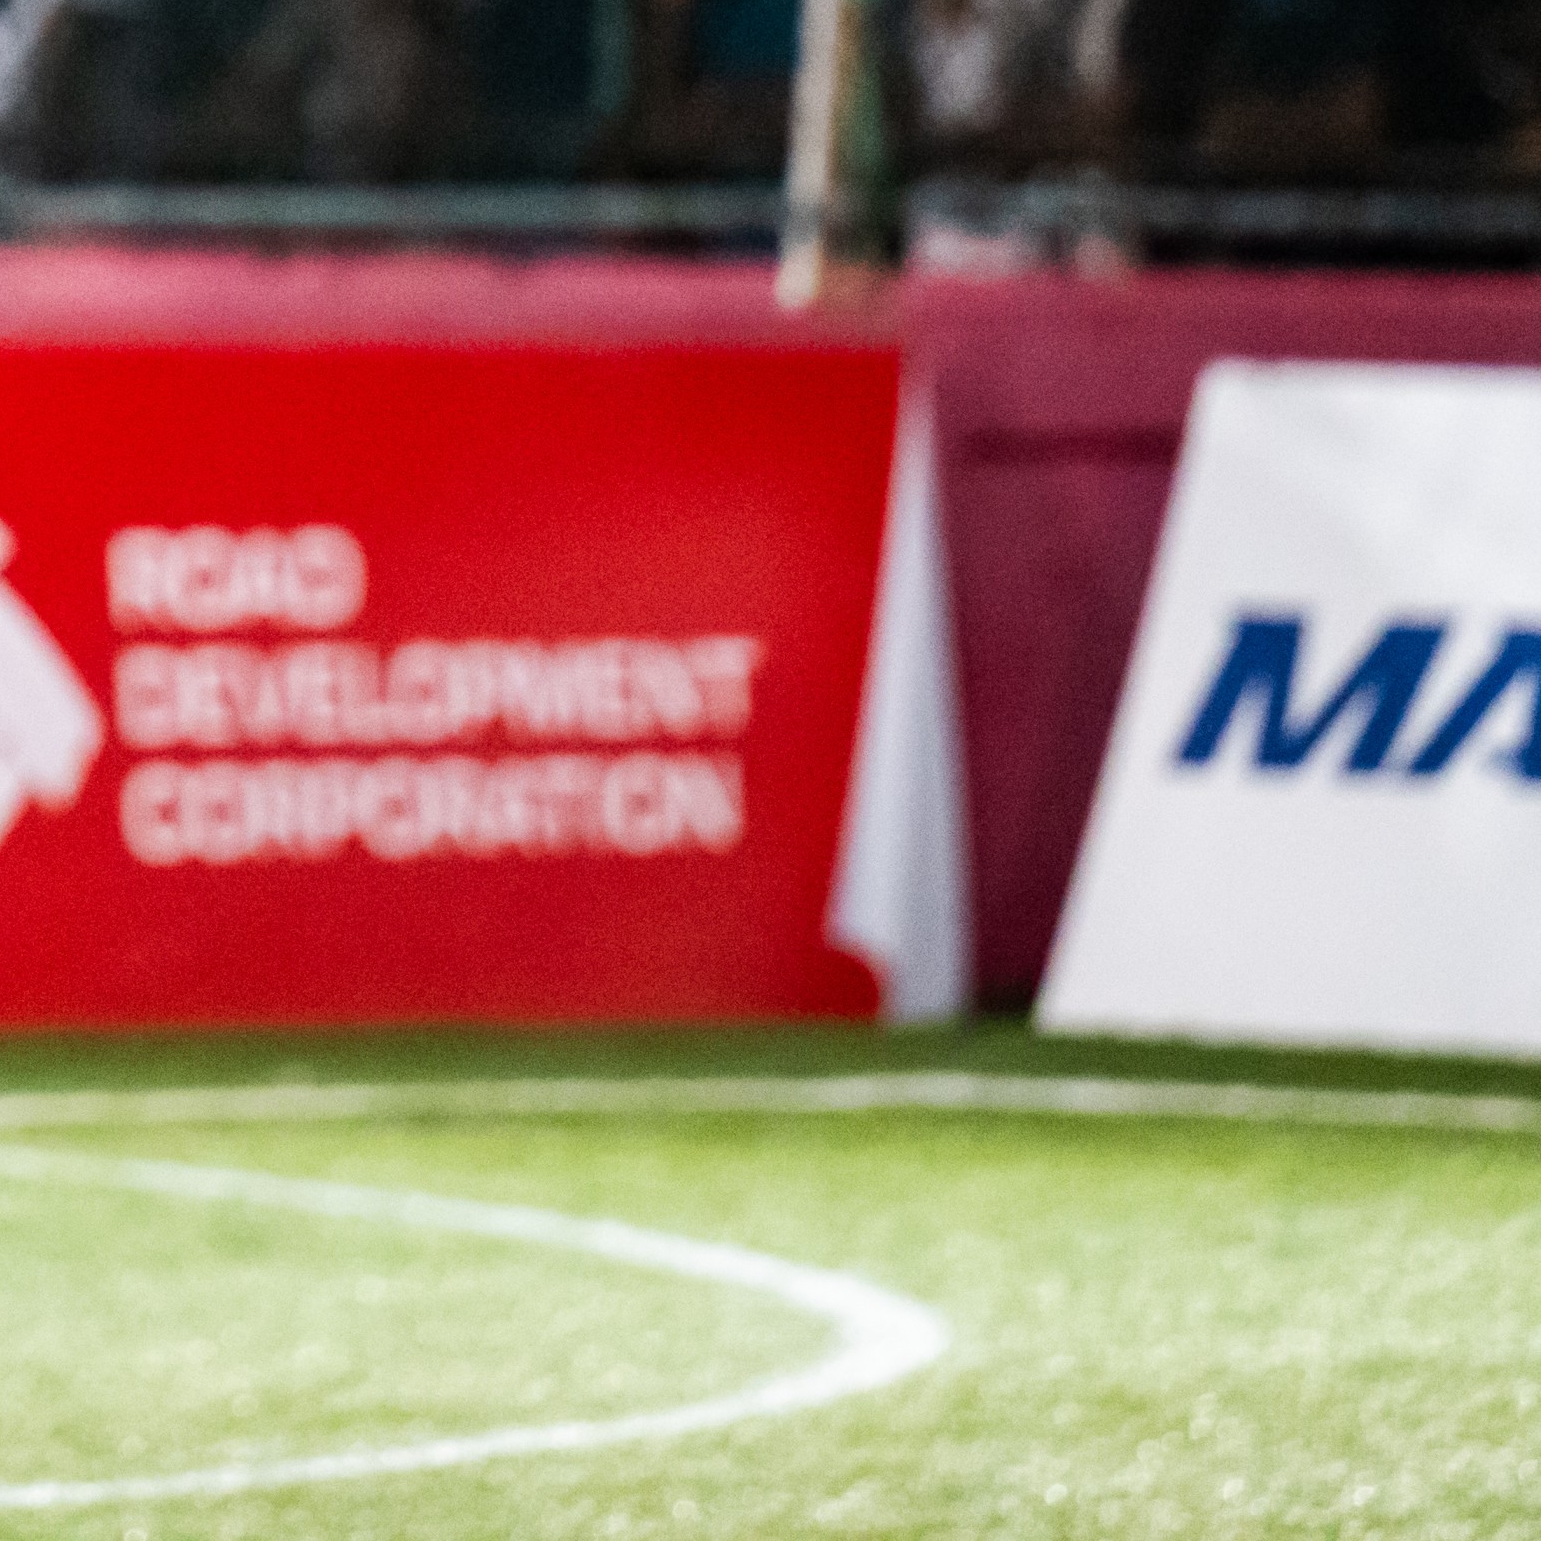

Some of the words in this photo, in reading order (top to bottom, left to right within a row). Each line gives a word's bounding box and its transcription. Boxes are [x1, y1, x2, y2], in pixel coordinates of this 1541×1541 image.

[108, 523, 366, 631] ROAD
[113, 634, 761, 748] DEVELOPMENT
[121, 754, 742, 864] CORPORATION
